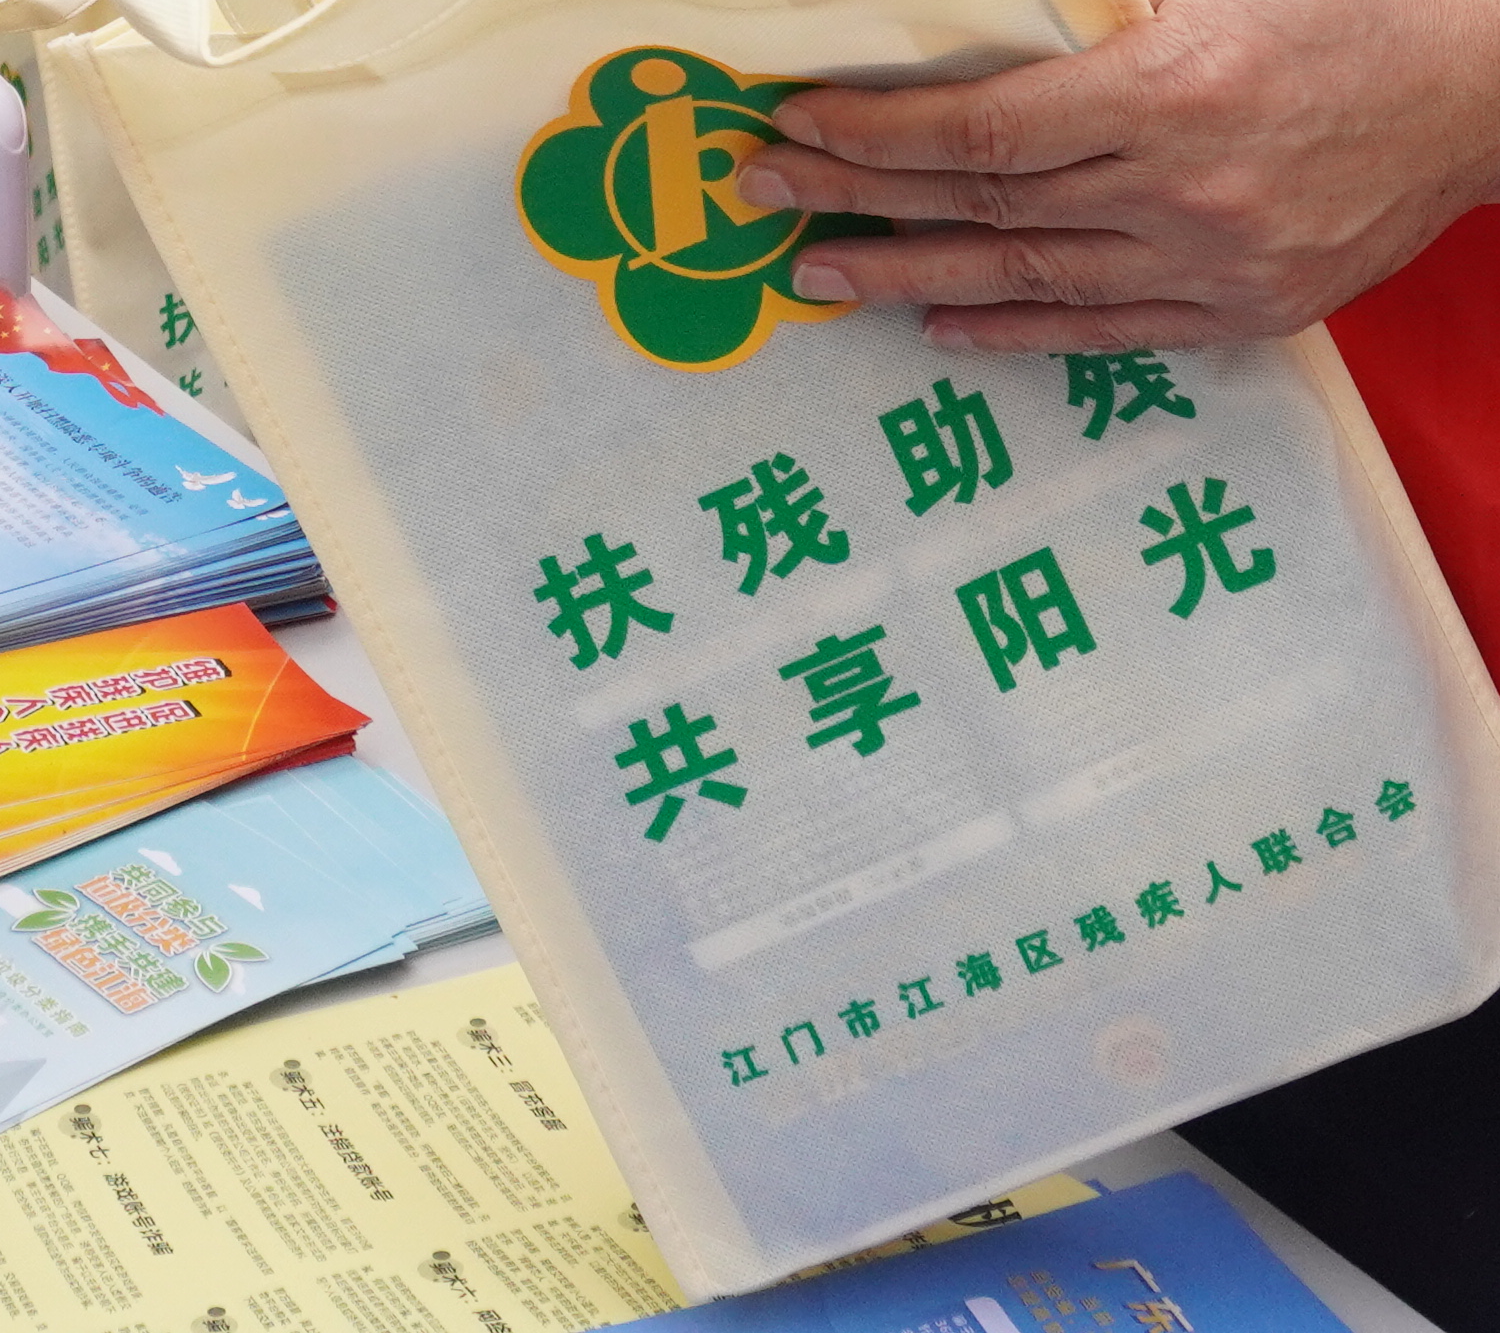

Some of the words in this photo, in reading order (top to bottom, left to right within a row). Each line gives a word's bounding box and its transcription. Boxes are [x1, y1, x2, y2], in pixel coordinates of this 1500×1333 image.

[534, 347, 1197, 671] 扶残助残
[615, 476, 1278, 844] 共享阳光
[72, 911, 191, 999] 携手共建
[74, 874, 202, 959] 垃圾分类
[112, 861, 229, 940] 共同参与
[720, 773, 1422, 1090] 江门市江海区残疾人联合会
[31, 928, 160, 1016] 绿色江海
[69, 1116, 174, 1257] 骗术七：游戏账号诈骗
